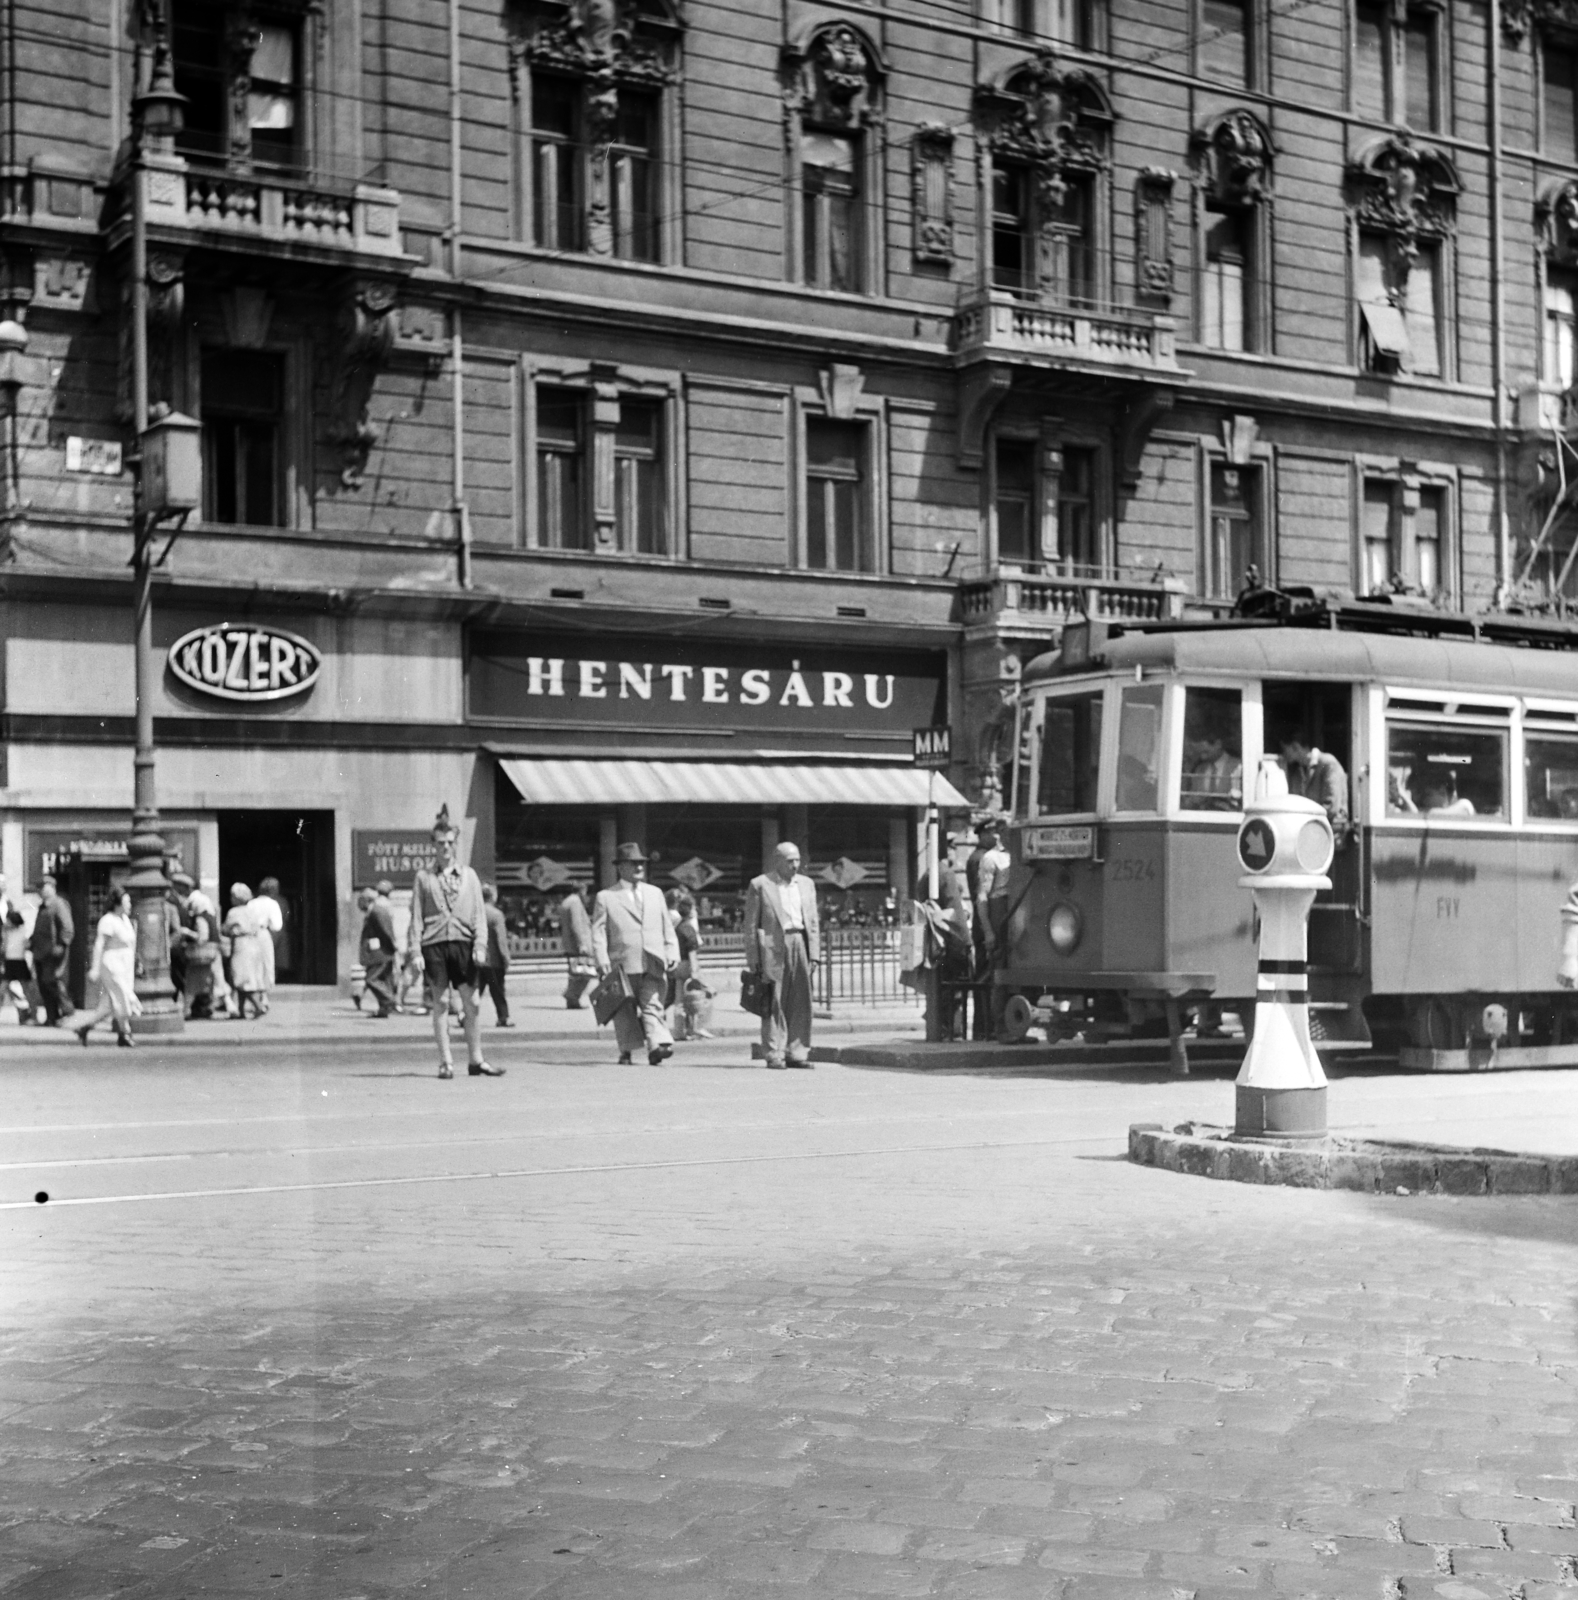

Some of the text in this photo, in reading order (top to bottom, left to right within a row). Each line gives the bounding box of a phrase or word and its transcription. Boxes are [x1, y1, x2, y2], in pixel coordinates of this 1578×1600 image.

[182, 629, 312, 691] KÖZÉRT
[526, 657, 895, 709] HENTESÁRU
[915, 730, 949, 754] MM
[1112, 859, 1156, 881] 2524
